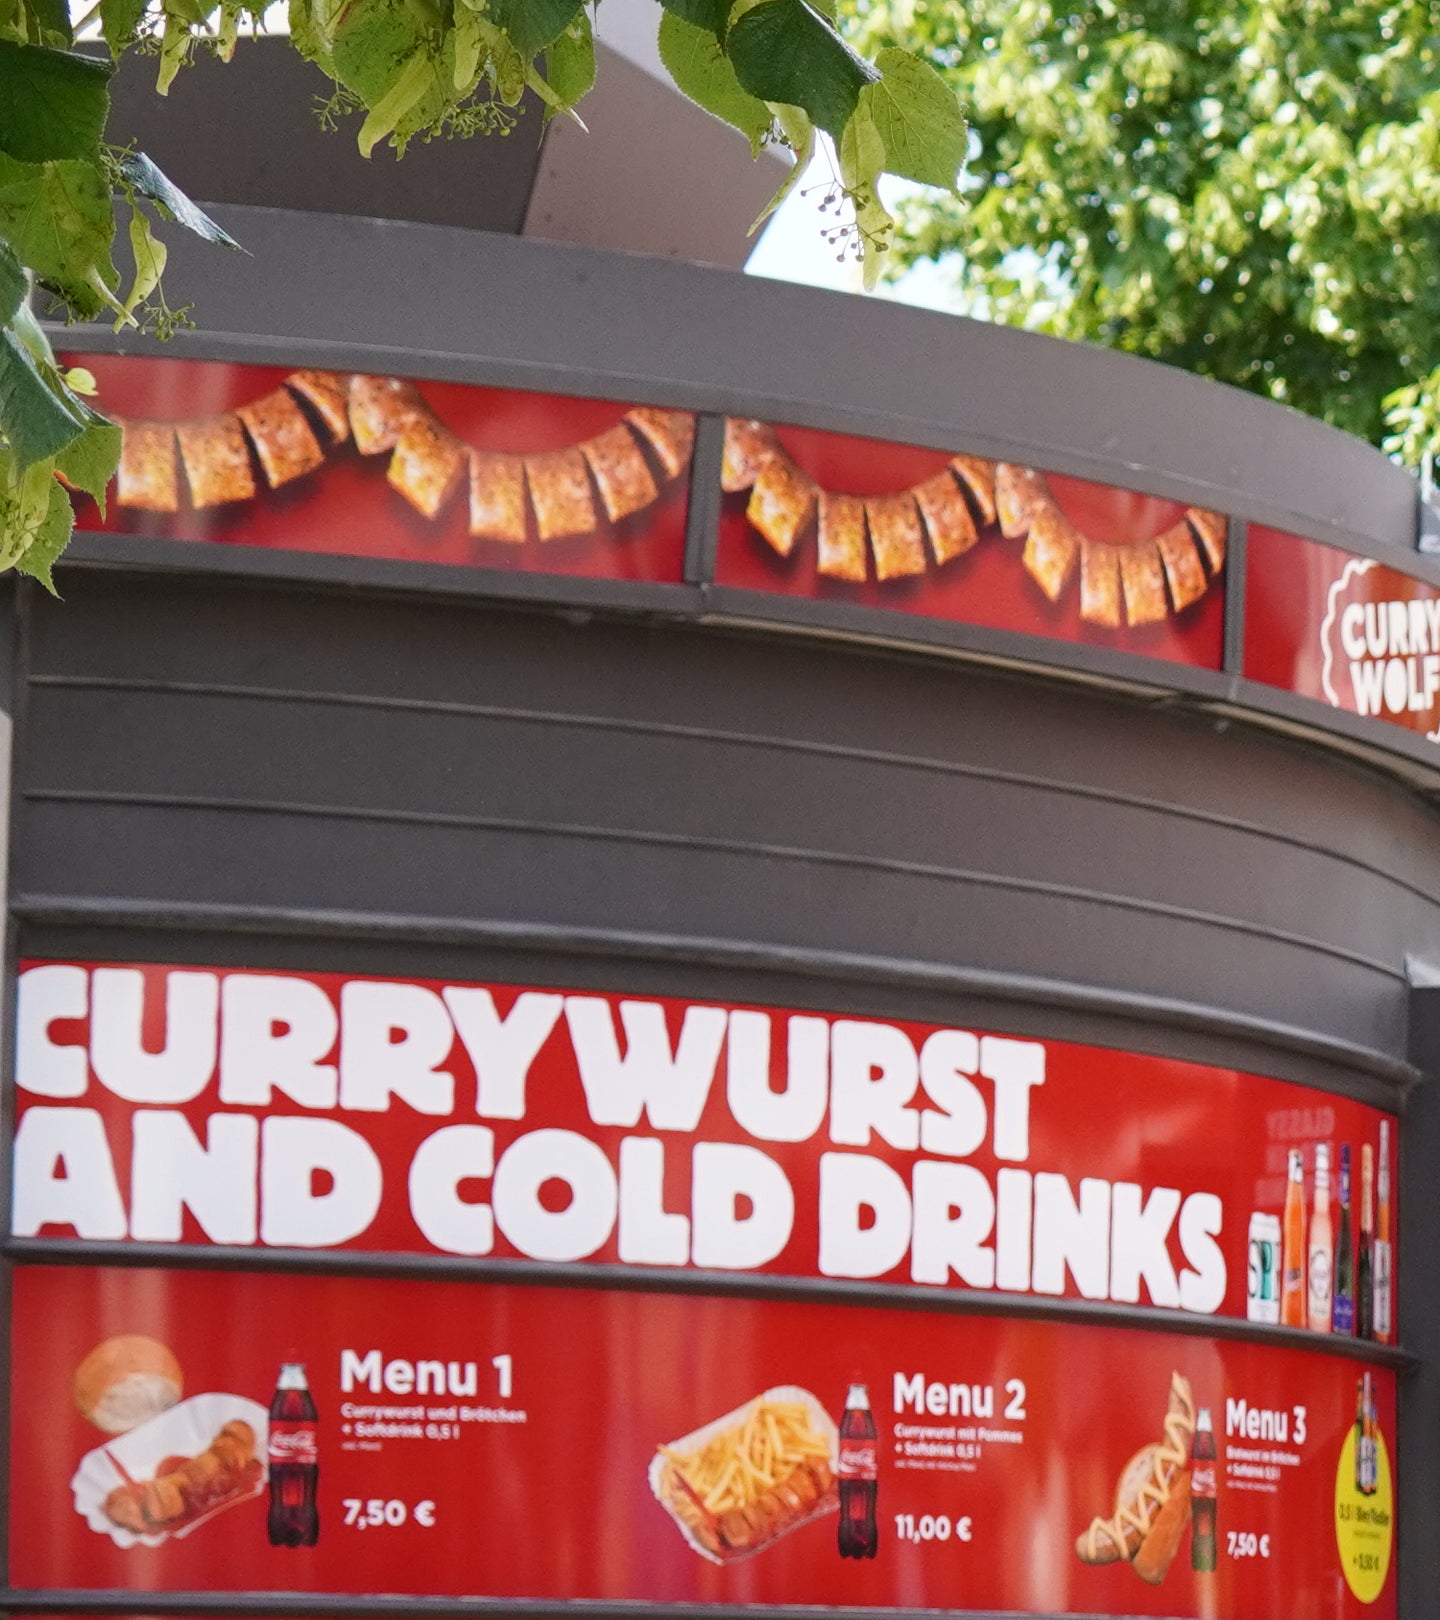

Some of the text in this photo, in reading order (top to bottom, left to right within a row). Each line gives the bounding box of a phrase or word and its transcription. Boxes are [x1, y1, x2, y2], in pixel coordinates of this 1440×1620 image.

[14, 963, 1046, 1161] CURRYWURST
[12, 1106, 383, 1246] AND
[408, 1124, 795, 1269] COLD
[819, 1151, 1228, 1314] DRINKS
[340, 1349, 512, 1398] Menu 1
[893, 1371, 1026, 1421] Menu 2
[1225, 1397, 1307, 1445] Menu 3
[342, 1499, 436, 1529] 7,50 €
[894, 1513, 973, 1544] 11,00 €
[1227, 1531, 1270, 1560] 7,50 €
